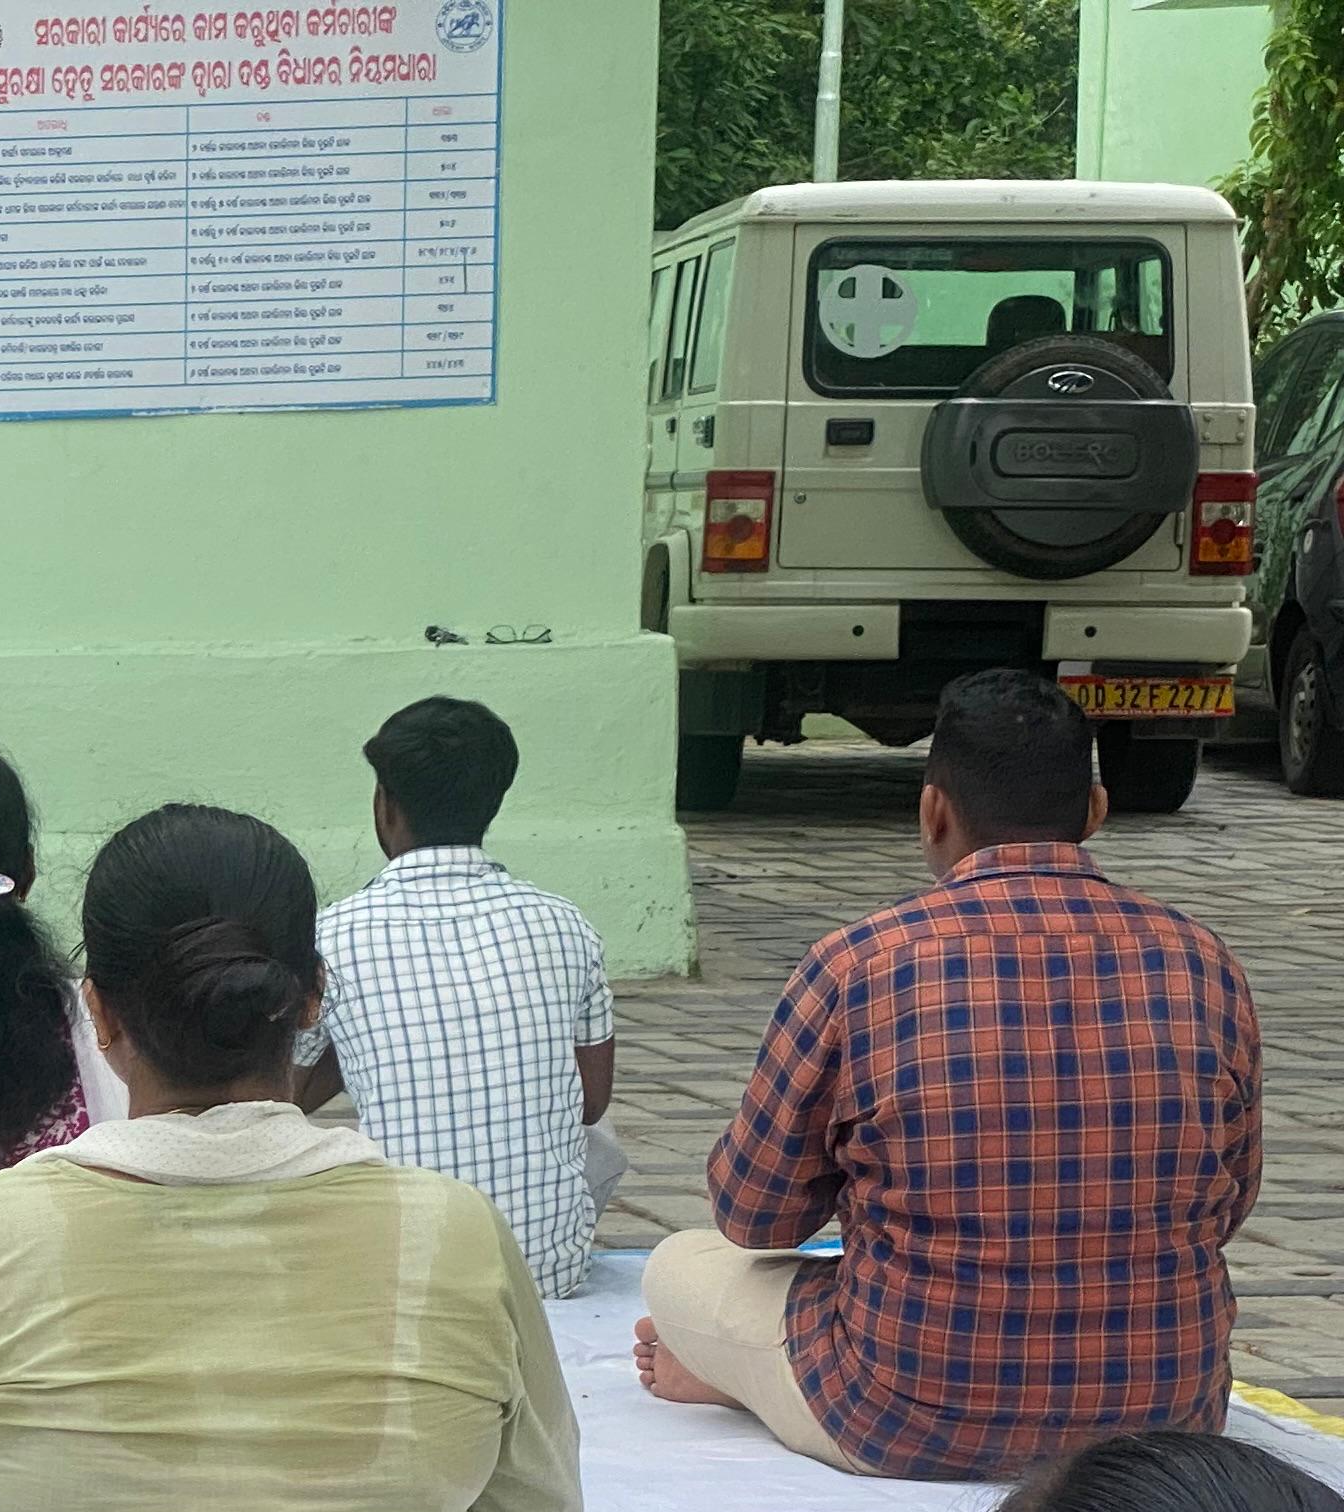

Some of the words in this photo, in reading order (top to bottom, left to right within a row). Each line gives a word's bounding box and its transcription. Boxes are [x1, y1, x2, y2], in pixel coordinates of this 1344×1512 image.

[34, 16, 107, 46] ସରକାରୀ
[192, 12, 228, 41] କାମ
[51, 65, 95, 101] ହେତୁ
[100, 61, 186, 92] ସରକାରଙ୍କ
[238, 59, 271, 90] ଦଣ୍ଡ
[277, 48, 343, 85] ବିଧାନର
